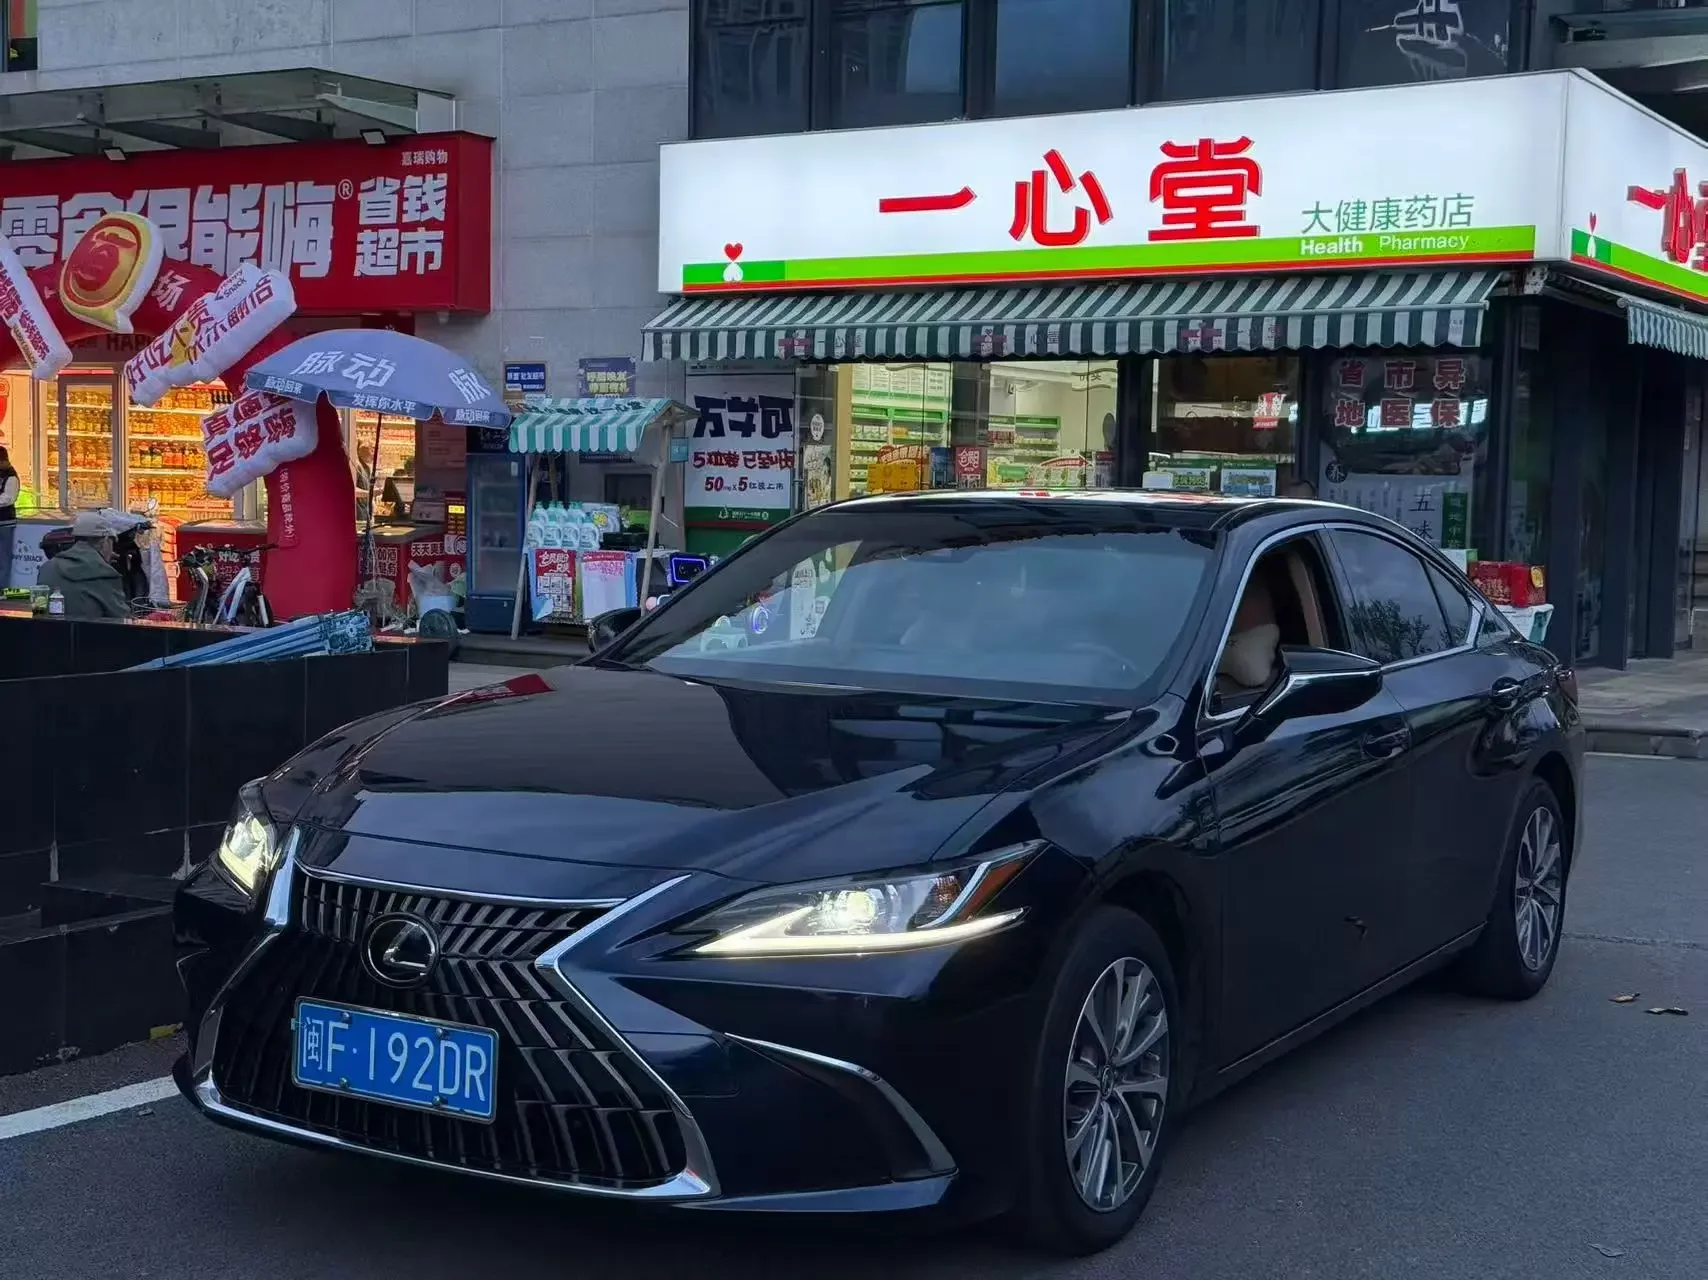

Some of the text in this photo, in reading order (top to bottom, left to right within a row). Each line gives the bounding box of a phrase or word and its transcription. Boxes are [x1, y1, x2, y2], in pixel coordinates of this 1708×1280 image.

[358, 172, 448, 226] 省钱
[879, 135, 1263, 247] 一心堂
[1301, 193, 1475, 234] 大健康药店
[353, 227, 444, 277] 超市
[1300, 234, 1470, 256] Health Pharmacy
[291, 350, 397, 390] 脉动
[448, 367, 491, 404] 脉
[351, 393, 417, 414] 发挥你水平
[1334, 397, 1462, 429] 地医保
